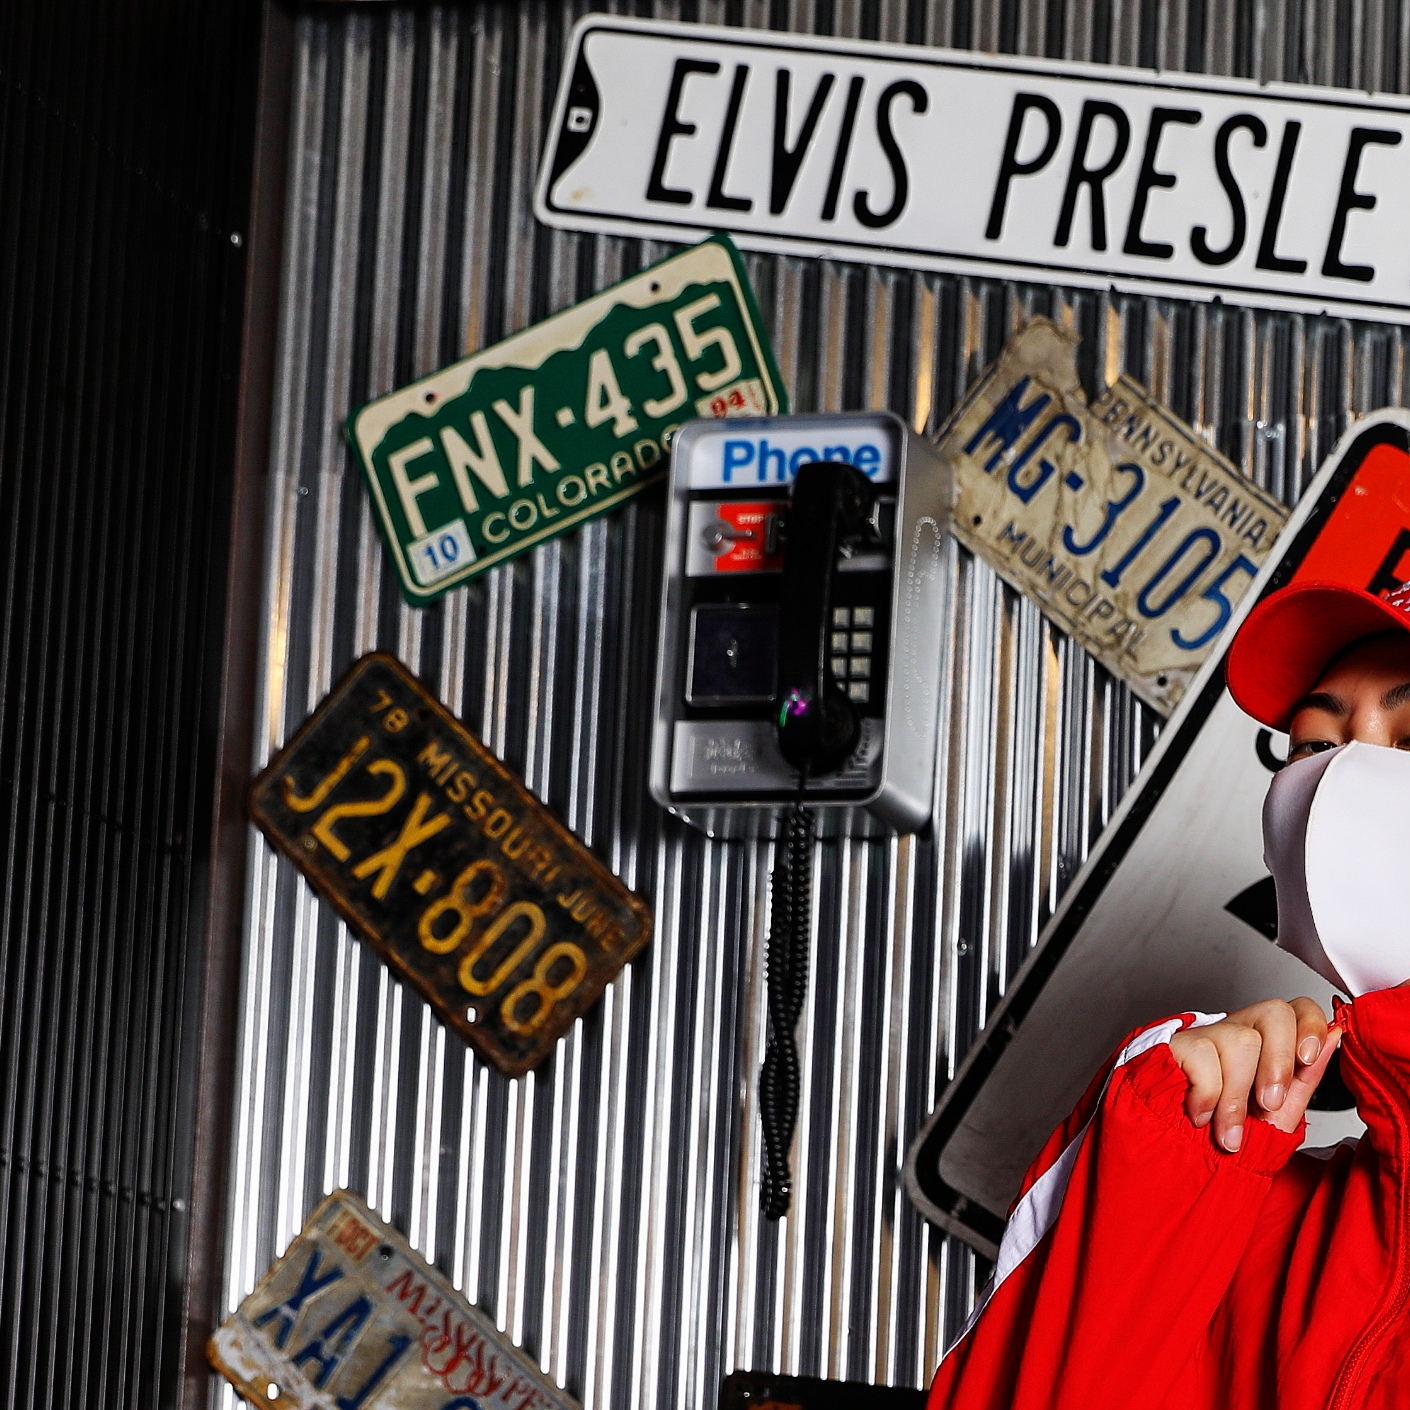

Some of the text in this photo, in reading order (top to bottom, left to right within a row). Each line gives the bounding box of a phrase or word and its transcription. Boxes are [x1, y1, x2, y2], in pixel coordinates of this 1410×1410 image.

[645, 57, 929, 229] ELVIS
[1101, 388, 1270, 550] PENNSYLVANIA
[424, 535, 460, 570] 10
[1000, 520, 1148, 660] MUNICIPAL
[366, 689, 410, 733] 78
[416, 739, 562, 886] MISSOURI
